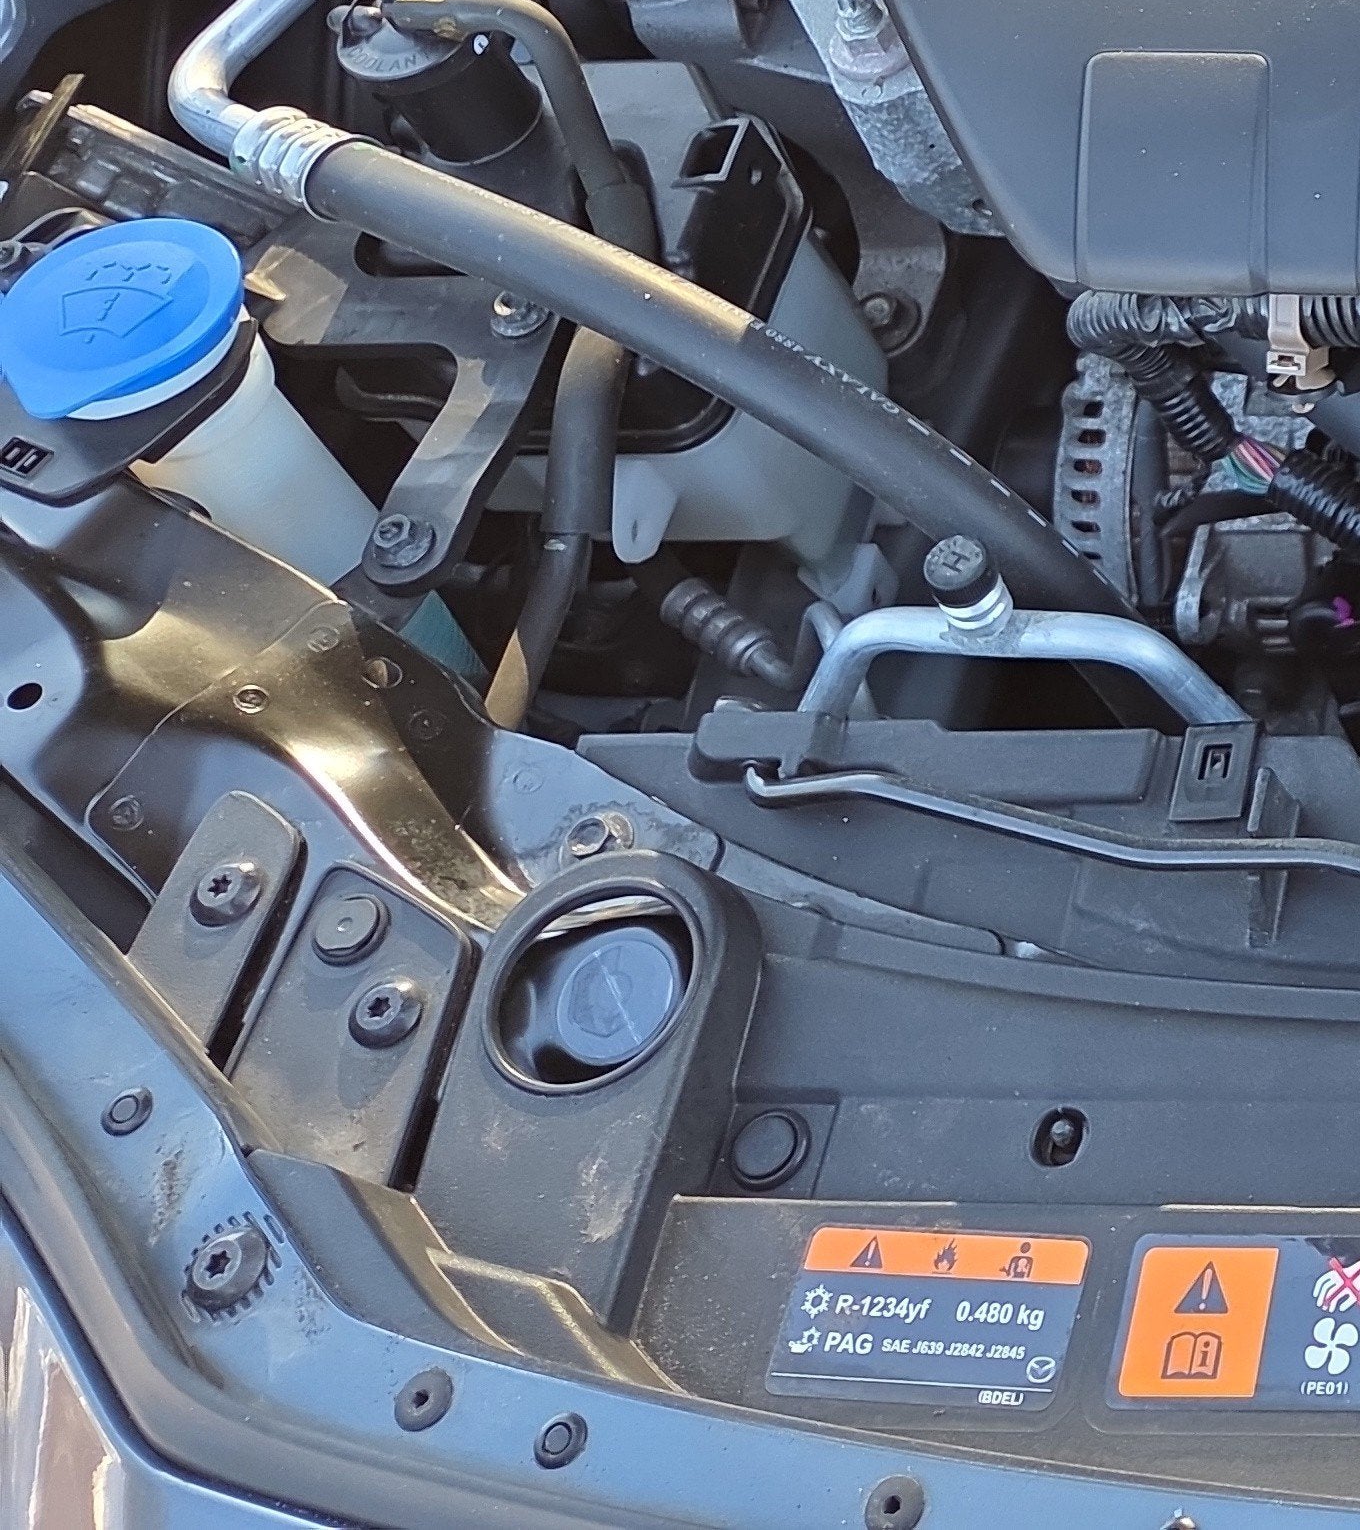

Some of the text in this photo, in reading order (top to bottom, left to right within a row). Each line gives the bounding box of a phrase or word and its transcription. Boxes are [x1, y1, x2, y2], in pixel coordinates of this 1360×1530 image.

[834, 1293, 1045, 1331] R-1234yf 0.480 kg
[823, 1331, 1026, 1360] PAG SAE J639 J2842 J2845
[1300, 1380, 1349, 1397] (PE01)
